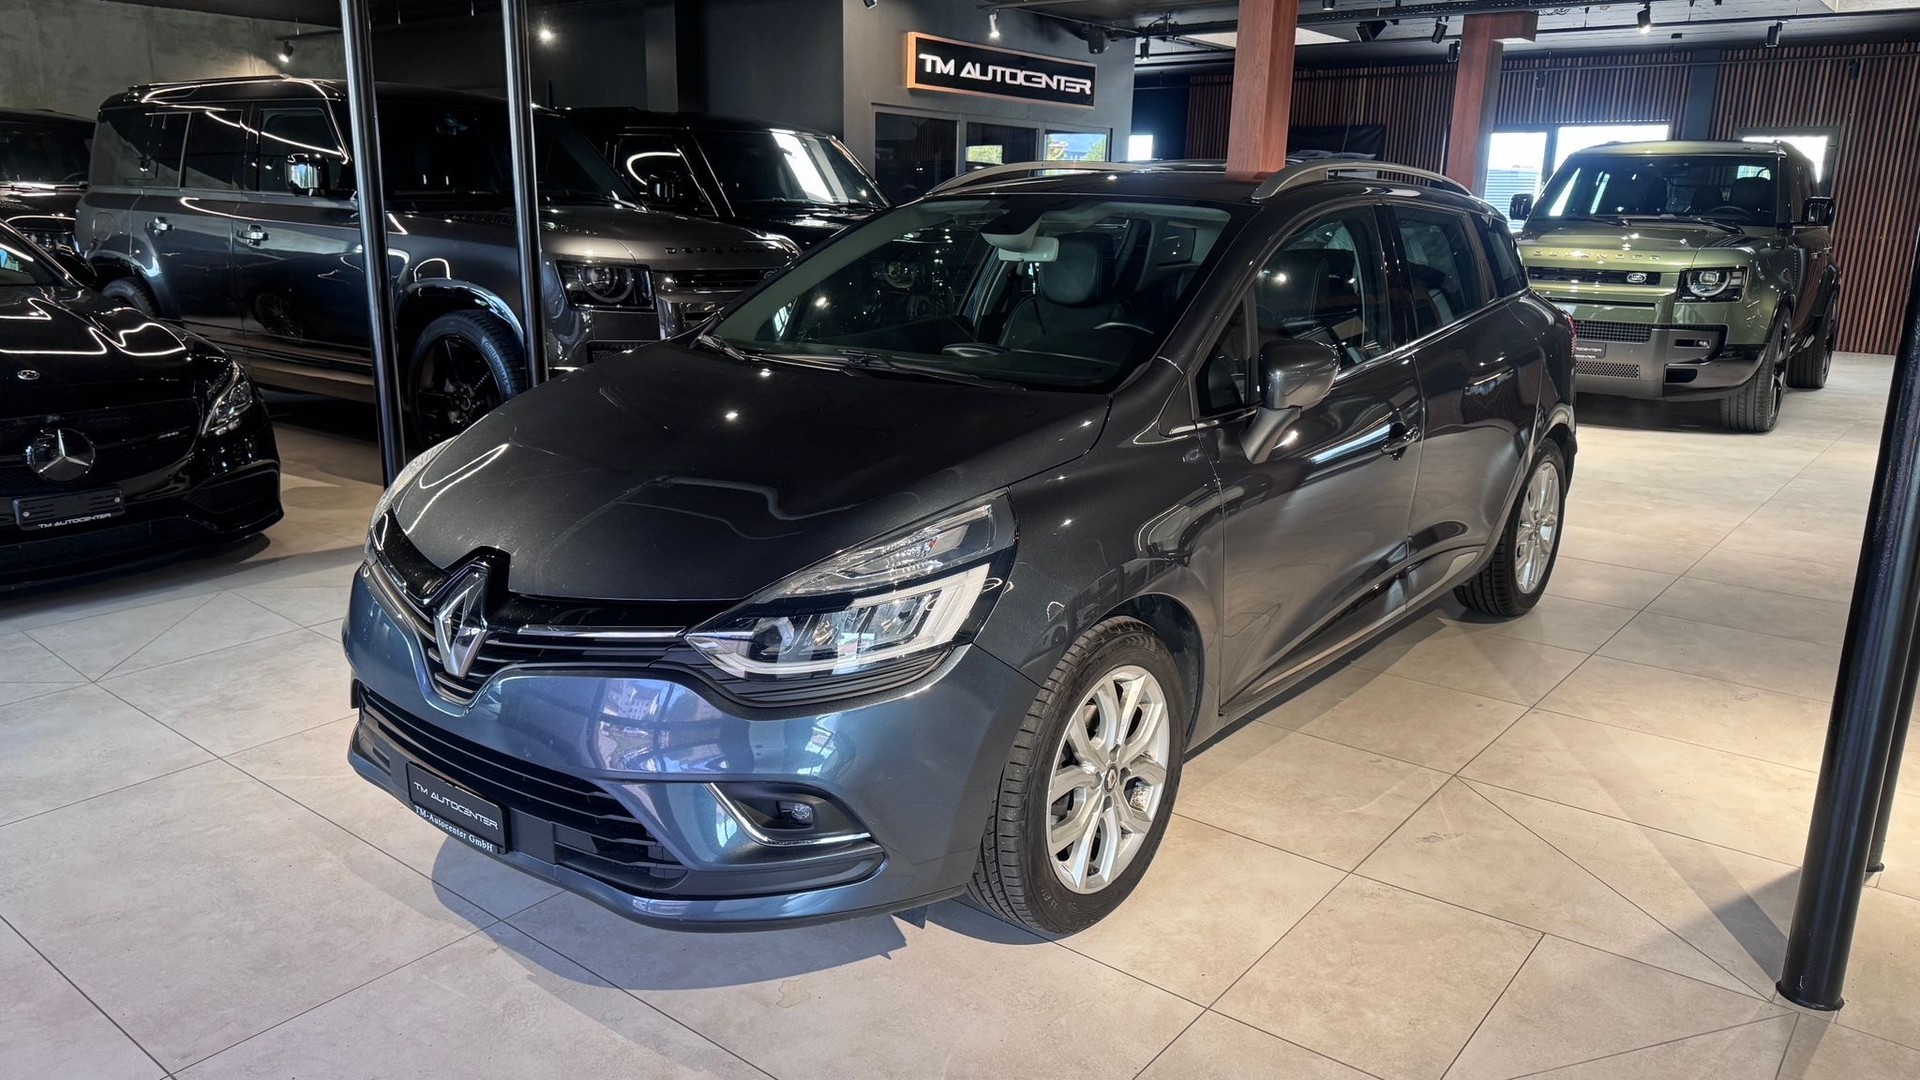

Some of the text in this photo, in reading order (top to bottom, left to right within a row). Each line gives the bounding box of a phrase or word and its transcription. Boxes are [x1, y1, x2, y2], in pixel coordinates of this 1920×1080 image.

[919, 54, 1091, 95] TM AUTOCENTER
[54, 513, 111, 526] AUTOCENTER
[413, 781, 498, 829] TM AUTOCENTER
[414, 805, 493, 852] TM-Autocenter GmbH
